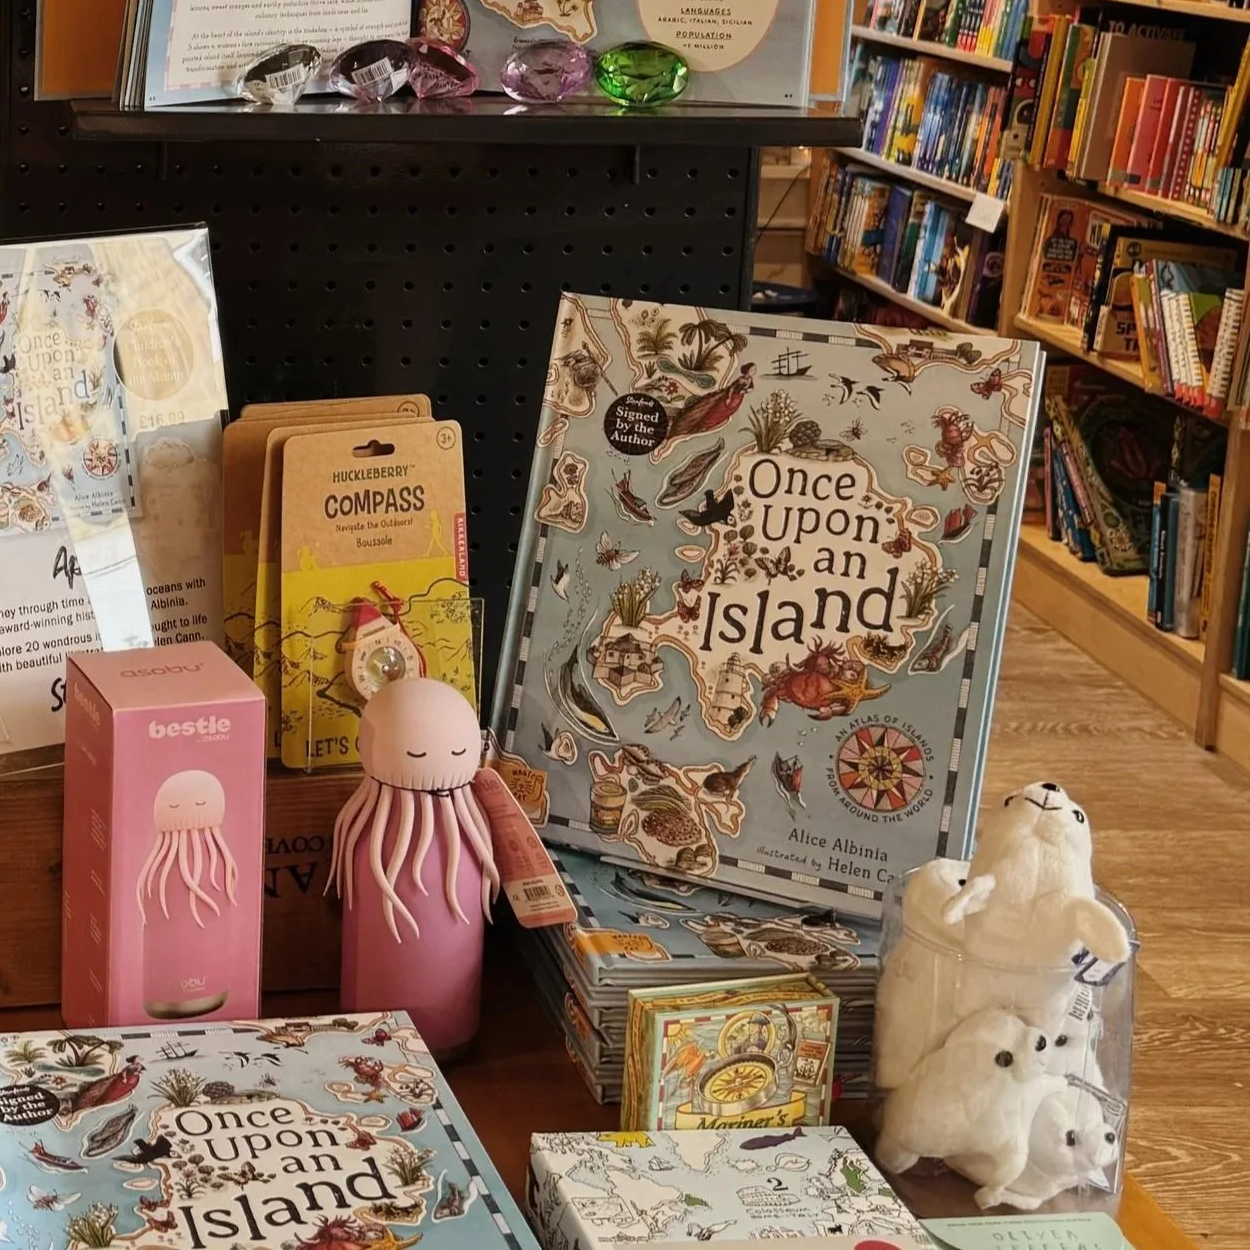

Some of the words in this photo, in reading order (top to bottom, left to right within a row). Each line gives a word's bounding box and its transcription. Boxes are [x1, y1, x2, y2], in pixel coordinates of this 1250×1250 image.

[680, 7, 732, 15] LANGUAGES
[675, 30, 733, 39] POPULATION
[18, 332, 60, 353] Once
[53, 366, 74, 381] an
[18, 369, 90, 430] Island
[616, 406, 659, 423] Signed
[616, 418, 631, 433] by
[634, 422, 655, 435] the
[610, 430, 655, 447] Author
[748, 457, 857, 503] Once
[324, 484, 425, 519] COMPASS
[336, 523, 365, 534] Navigate
[367, 520, 379, 529] the
[761, 504, 882, 546] Upon
[356, 535, 393, 548] Boussole
[813, 547, 867, 580] an
[146, 582, 183, 596] oceans
[185, 578, 206, 590] with
[18, 600, 59, 618] through
[61, 597, 85, 609] time
[151, 598, 189, 610] Albinia.
[698, 566, 900, 655] Island
[180, 617, 189, 627] to
[191, 614, 208, 625] life
[25, 641, 40, 652] 20
[42, 633, 93, 649] wondrous
[15, 653, 62, 670] beautiful
[120, 662, 204, 678] asobu
[834, 729, 848, 742] AN
[849, 714, 880, 729] ATLAS
[883, 715, 898, 724] OF
[901, 721, 935, 762] ISLANDS
[305, 738, 349, 759] LET'S
[826, 767, 840, 797] FROM
[840, 798, 879, 823] AROUND
[883, 814, 903, 824] THE
[904, 788, 934, 818] WORLD
[788, 828, 827, 848] Alice
[832, 837, 888, 862] Albinia
[756, 846, 807, 864] illustrated
[811, 858, 822, 872] by
[828, 857, 871, 880] Helen
[0, 1105, 18, 1114] by
[22, 1101, 46, 1110] the
[3, 1108, 53, 1122] Author
[175, 1106, 294, 1137] Once
[204, 1127, 340, 1161] Upon
[280, 1153, 343, 1174] an
[766, 1177, 789, 1191] 2
[178, 1156, 397, 1250] Island
